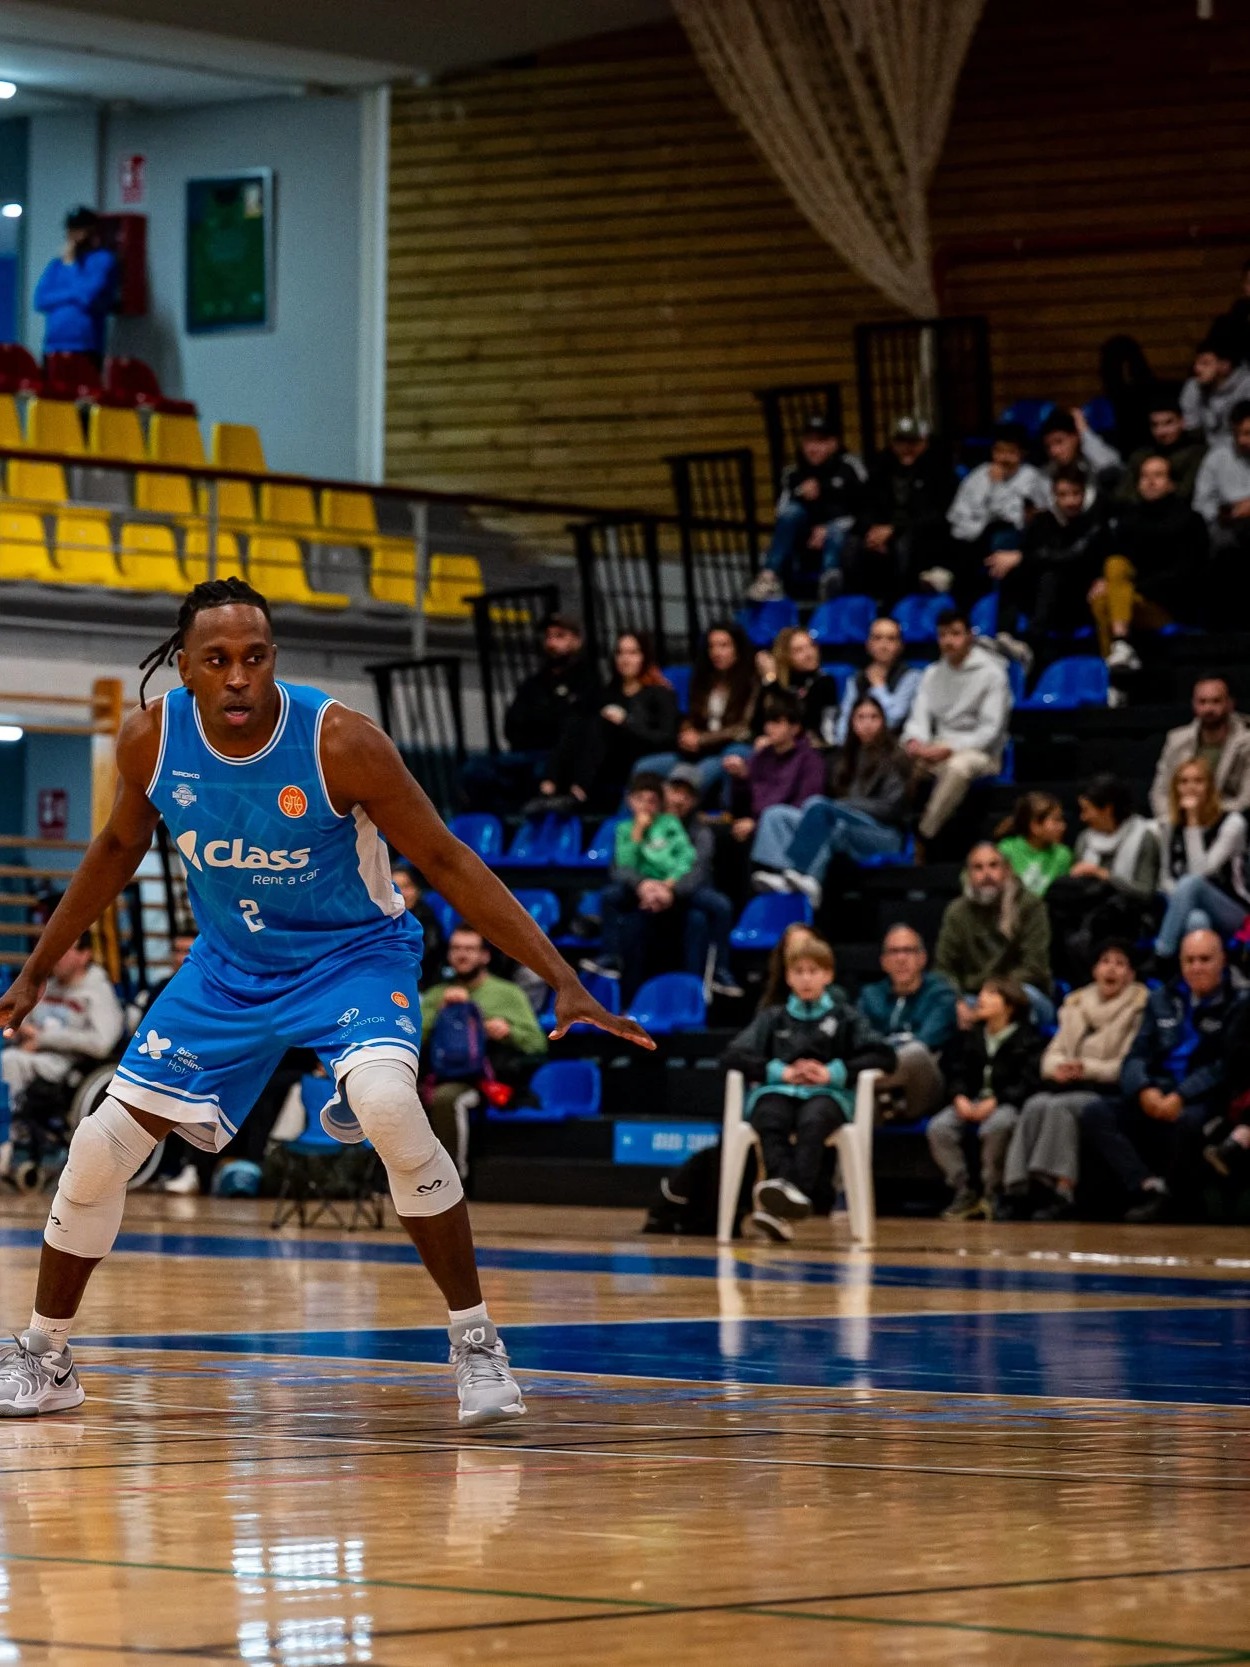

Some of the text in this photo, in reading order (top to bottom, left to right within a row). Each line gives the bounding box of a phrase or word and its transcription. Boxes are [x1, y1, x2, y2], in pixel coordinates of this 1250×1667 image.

[203, 838, 311, 871] Class
[252, 874, 283, 885] Rent
[287, 876, 296, 885] a
[239, 899, 266, 933] 2
[176, 1046, 198, 1060] Ibiza
